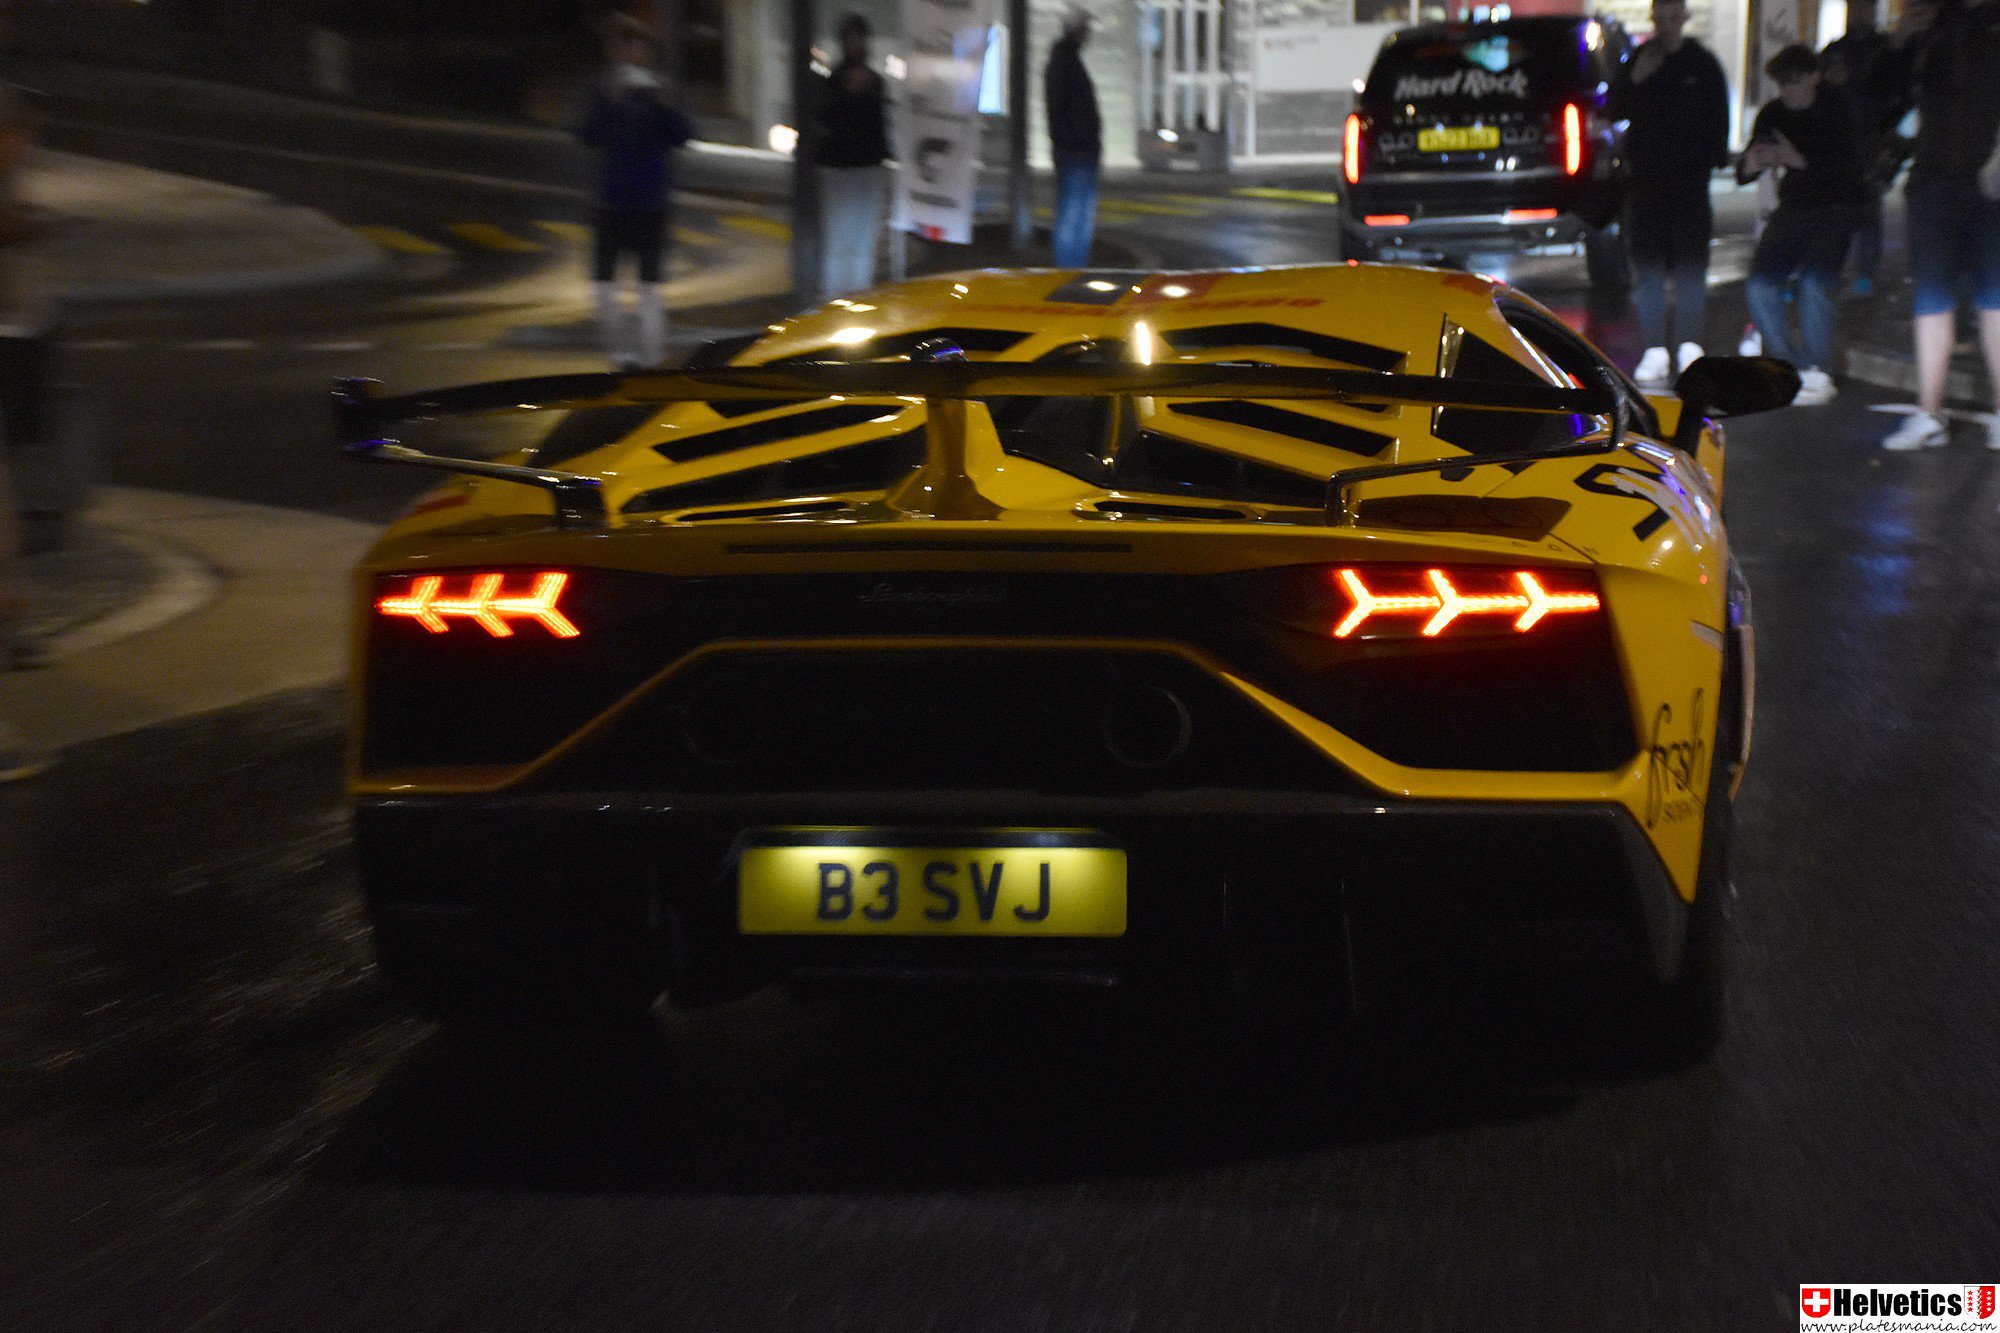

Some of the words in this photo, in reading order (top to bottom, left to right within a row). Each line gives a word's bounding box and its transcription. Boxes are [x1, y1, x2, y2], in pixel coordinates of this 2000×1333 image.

[1394, 68, 1463, 100] Hard
[1463, 67, 1529, 98] Rock
[818, 862, 898, 922] B3
[921, 862, 1051, 922] SVJ
